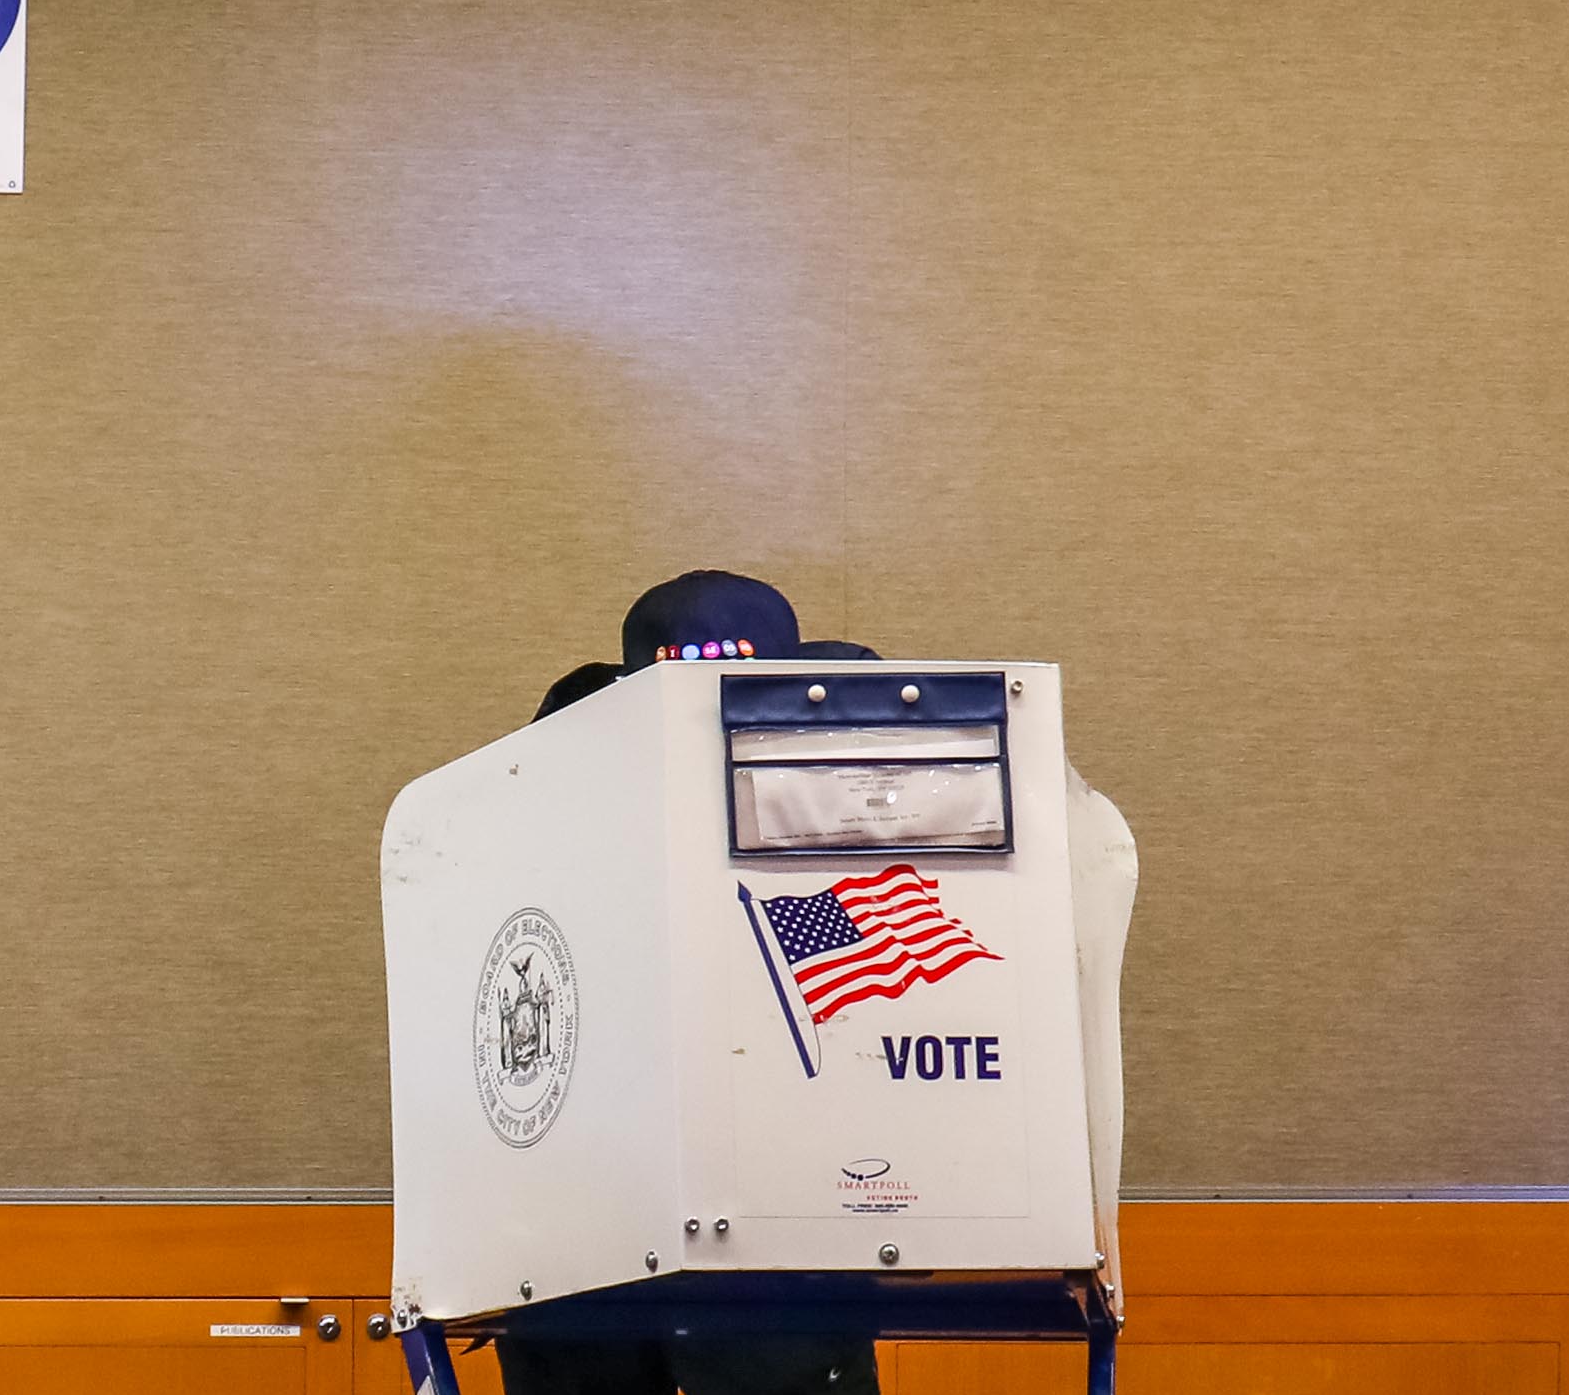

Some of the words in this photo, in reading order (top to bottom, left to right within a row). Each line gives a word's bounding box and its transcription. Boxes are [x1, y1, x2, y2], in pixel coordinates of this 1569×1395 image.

[880, 1035, 1002, 1080] VOTE
[837, 1181, 910, 1190] SMARTPOLL
[220, 1326, 291, 1335] PUBLICATIONS
